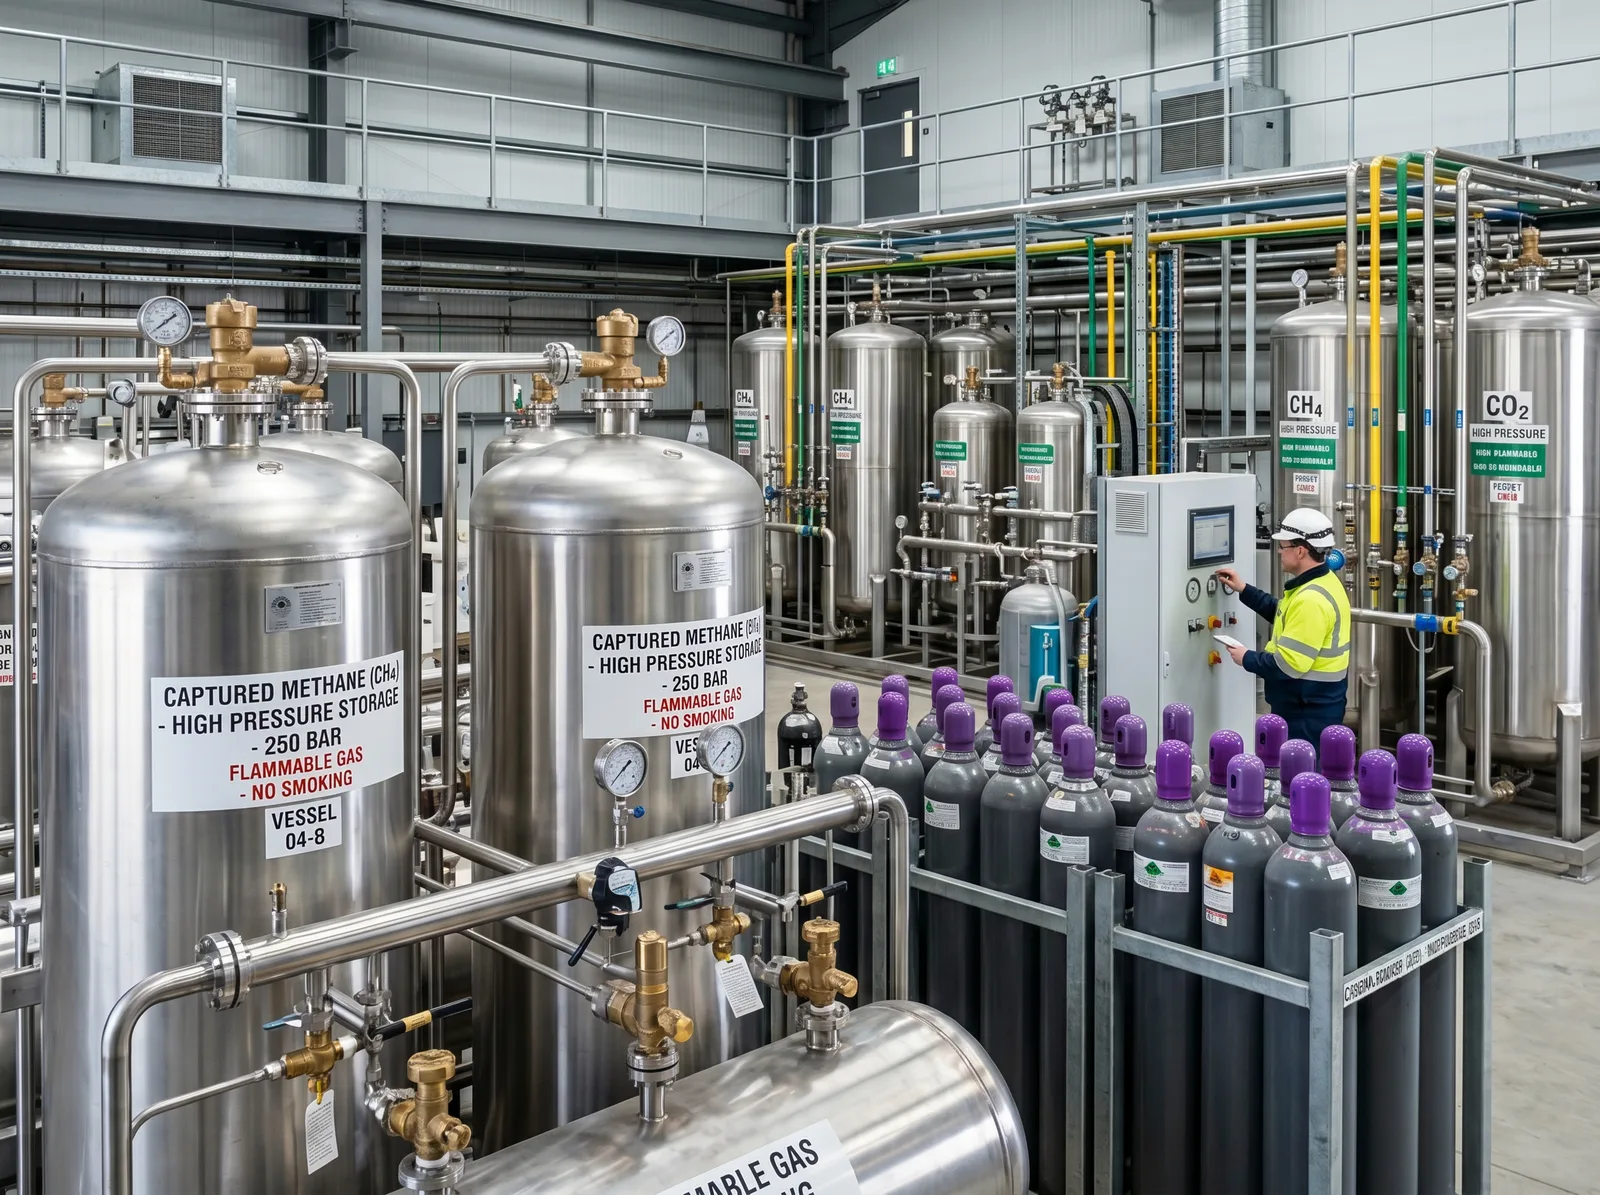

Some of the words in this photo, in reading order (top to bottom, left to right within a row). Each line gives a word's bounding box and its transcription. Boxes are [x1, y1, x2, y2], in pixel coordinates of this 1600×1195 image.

[1290, 394, 1322, 417] CH4
[1486, 394, 1529, 420] CO2
[1296, 425, 1337, 435] PRESSURE
[1472, 428, 1491, 438] HIGH
[1494, 428, 1546, 439] PRESSURE
[592, 630, 680, 651] CAPTURED
[686, 621, 743, 646] METHANE
[600, 656, 641, 674] HIGH
[647, 648, 722, 673] PRESSURE
[164, 682, 274, 707] CAPTURED
[282, 669, 365, 700] METHANE
[370, 659, 399, 690] (CH4)
[672, 675, 699, 692] 250
[703, 669, 728, 689] BAR
[173, 714, 222, 735] HIGH
[230, 701, 333, 733] PRESSURE
[339, 686, 399, 719] STORAGE
[644, 691, 721, 714] FLAMMABLE
[723, 686, 742, 703] GAS
[661, 714, 679, 730] NO
[683, 706, 735, 728] SMOKING
[264, 733, 300, 756] 250
[306, 727, 342, 750] BAR
[676, 737, 699, 755] VES
[229, 753, 332, 781] FLAMMABLE
[337, 746, 363, 766] GAS
[684, 757, 700, 772] 04
[252, 782, 276, 801] NO
[281, 769, 352, 797] SMOKING
[271, 803, 337, 830] VESSEL
[285, 827, 325, 850] 04-8
[683, 1160, 771, 1195] ABLE
[769, 1138, 819, 1179] GAS
